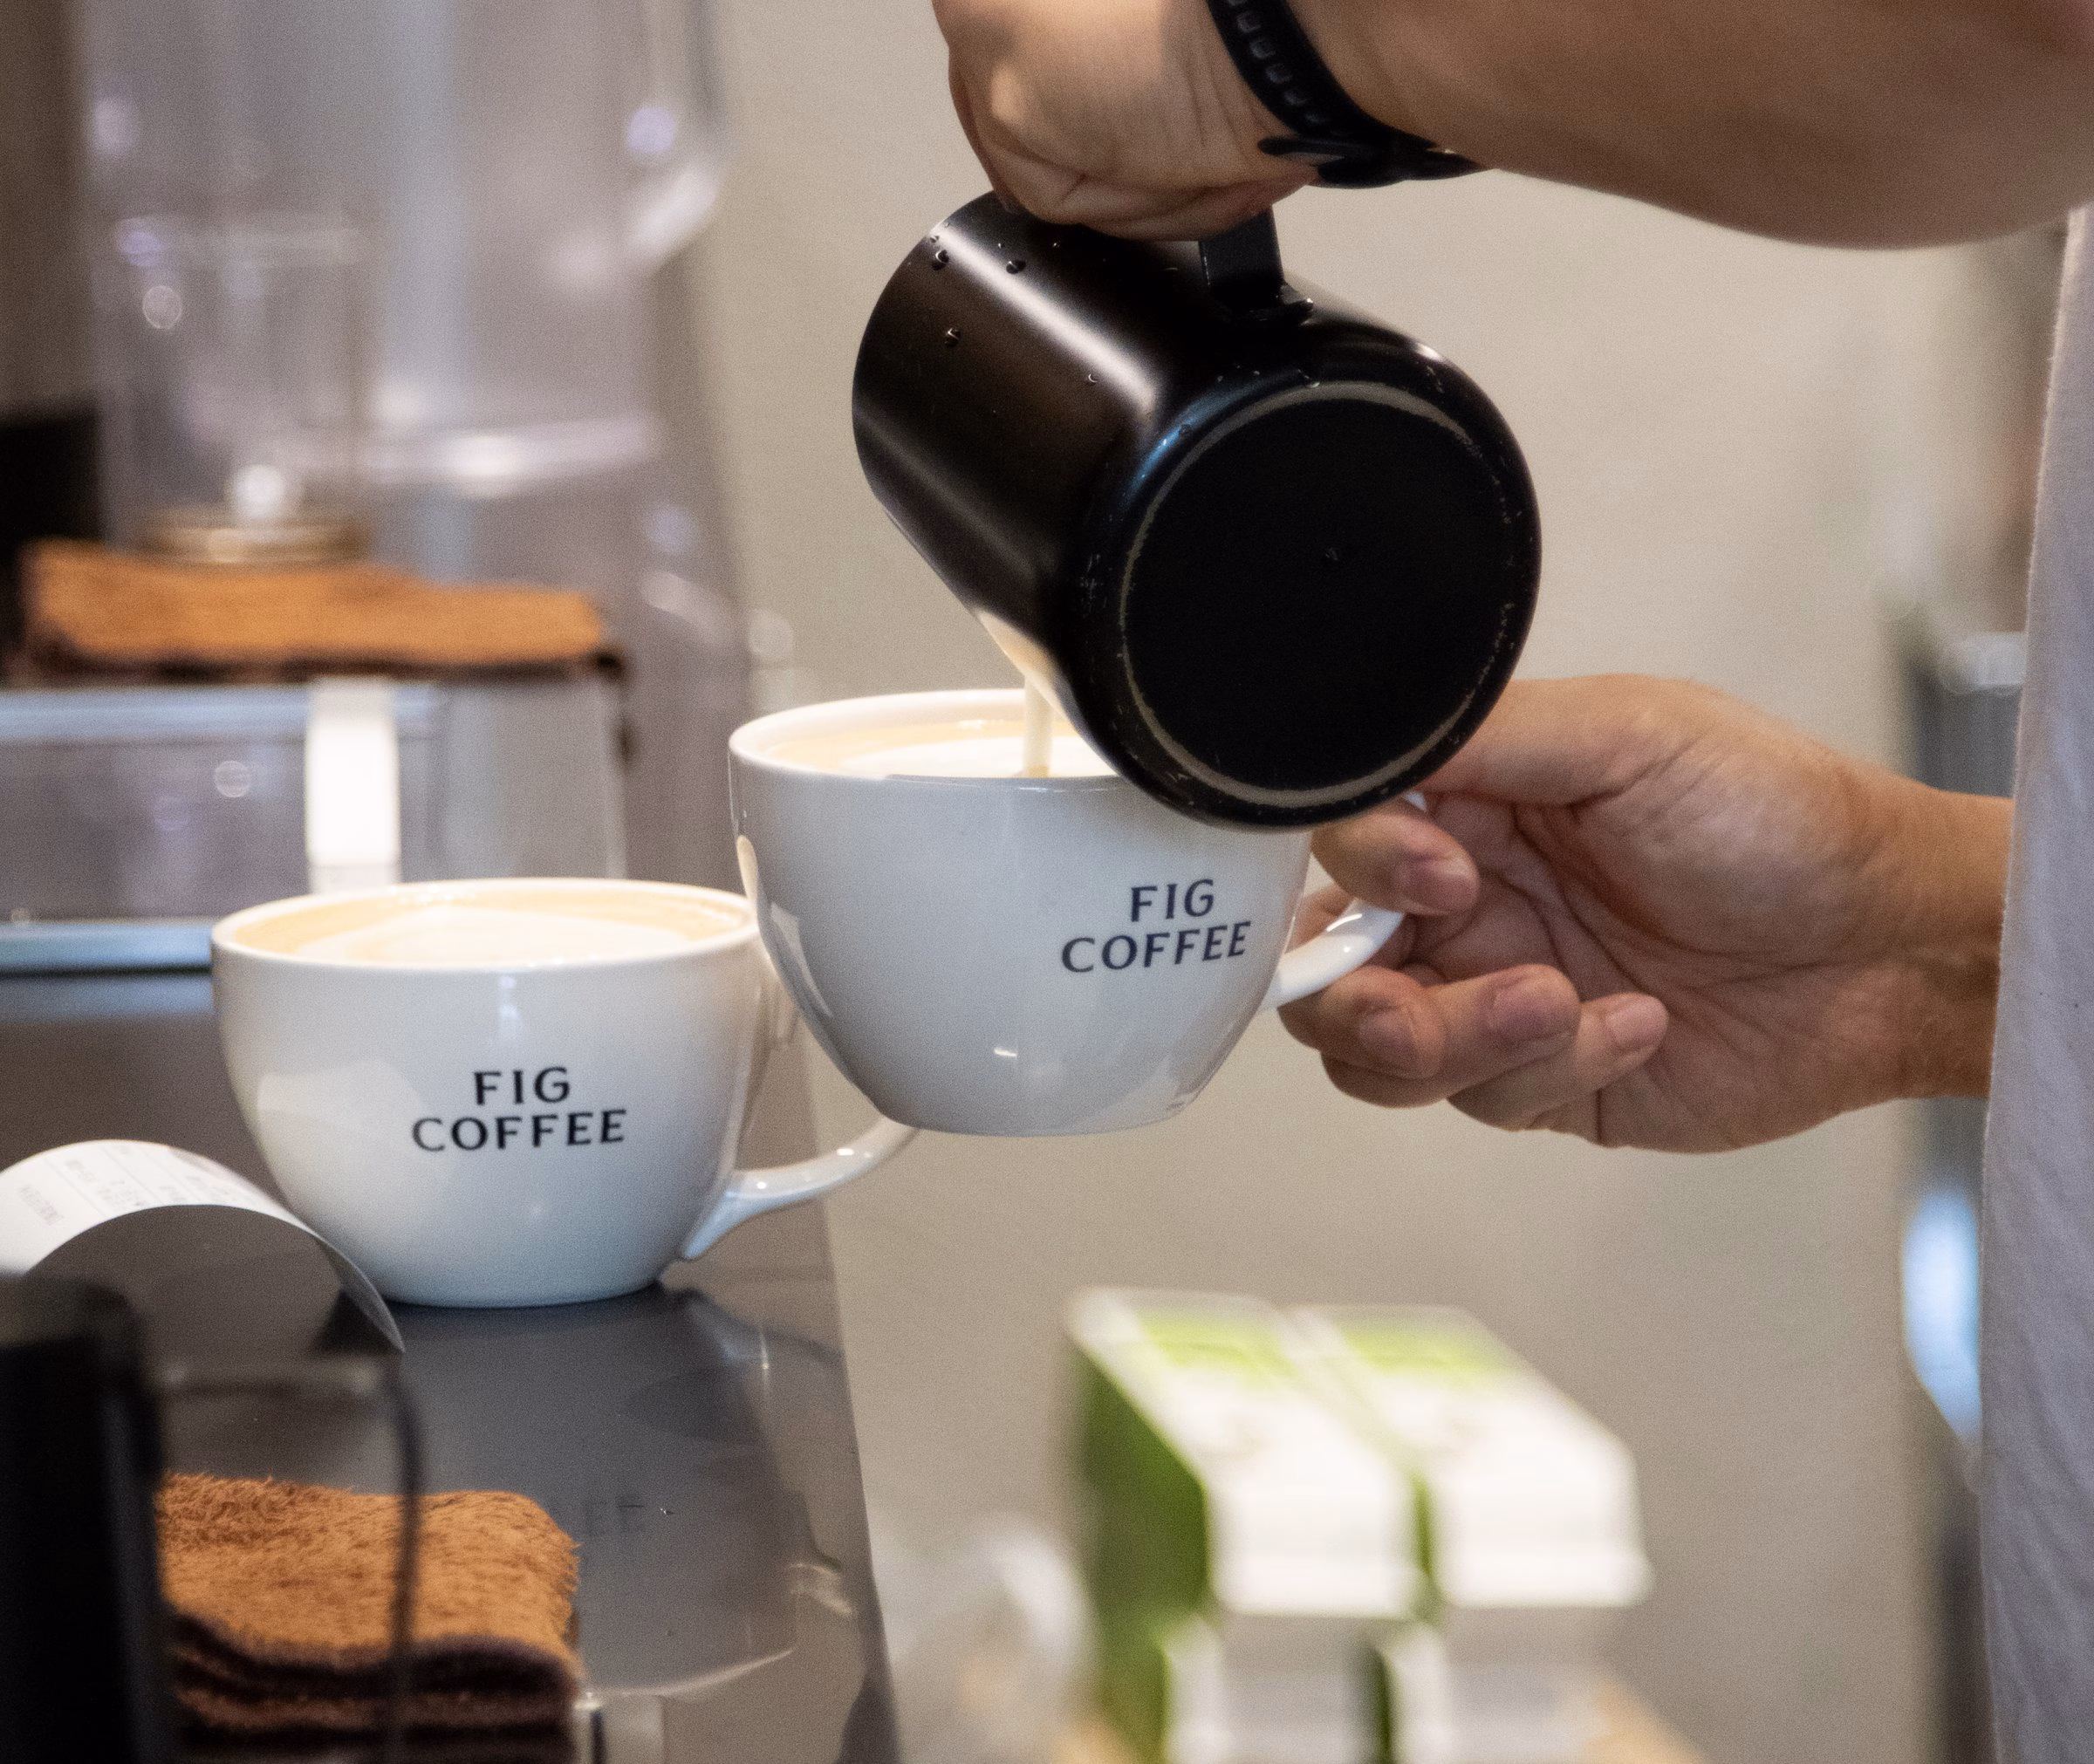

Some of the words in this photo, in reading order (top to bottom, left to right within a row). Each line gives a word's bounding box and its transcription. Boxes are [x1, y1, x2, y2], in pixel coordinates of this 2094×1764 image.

[1130, 879, 1215, 921] FIG
[1062, 920, 1252, 973] COFFEE
[474, 1066, 571, 1105] FIG
[412, 1109, 627, 1152] COFFEE
